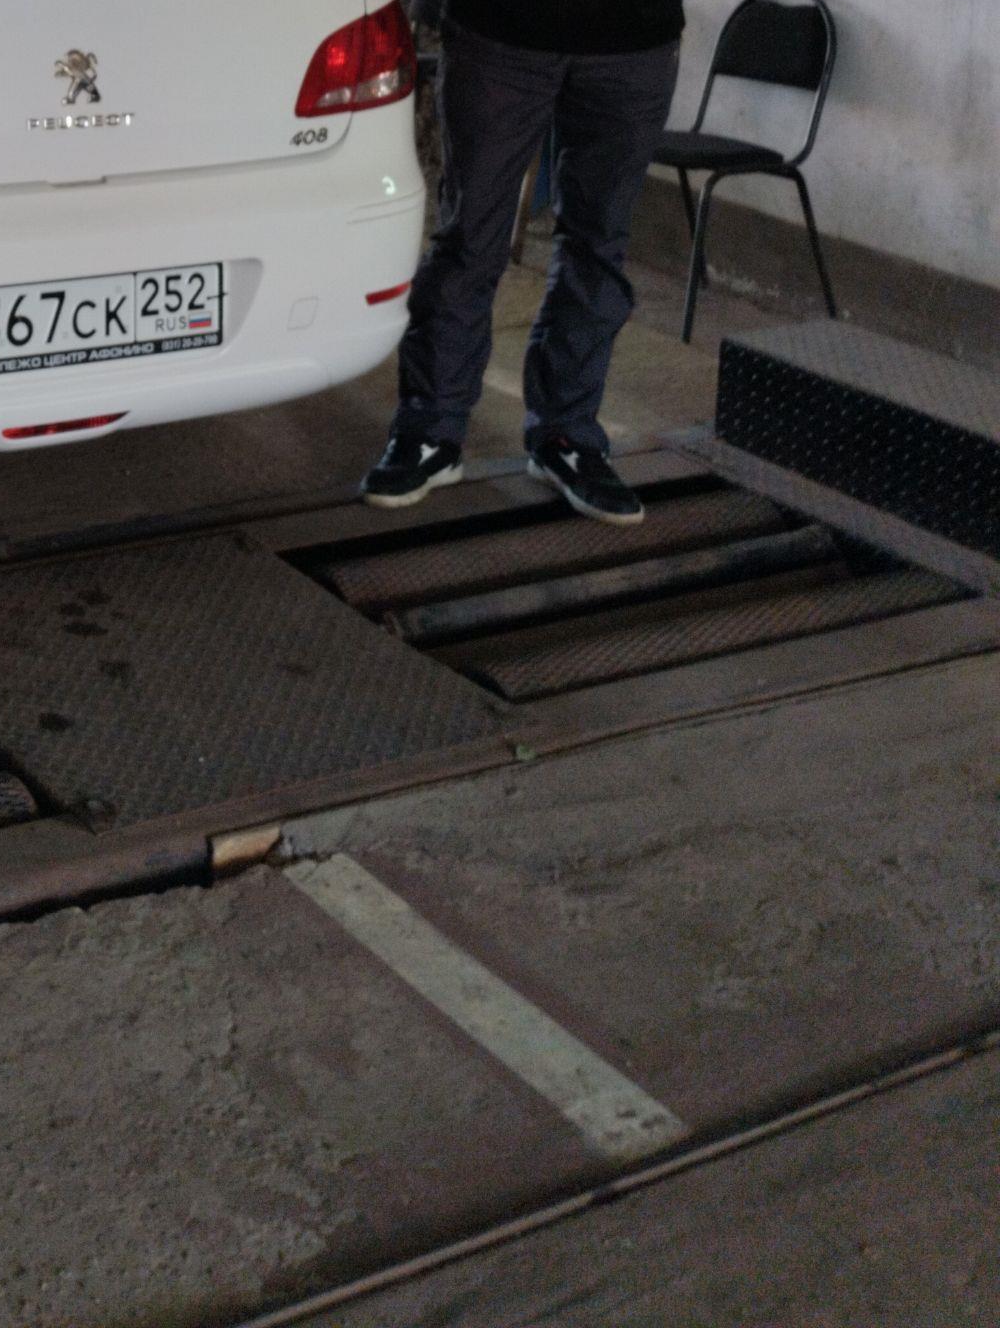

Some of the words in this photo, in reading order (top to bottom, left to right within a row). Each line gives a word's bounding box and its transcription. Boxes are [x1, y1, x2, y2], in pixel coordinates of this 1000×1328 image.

[27, 112, 135, 131] PEUGEOT
[290, 128, 328, 146] 408
[141, 273, 205, 316] 252
[155, 316, 187, 332] RUS
[43, 351, 87, 367] ЦЕНТР
